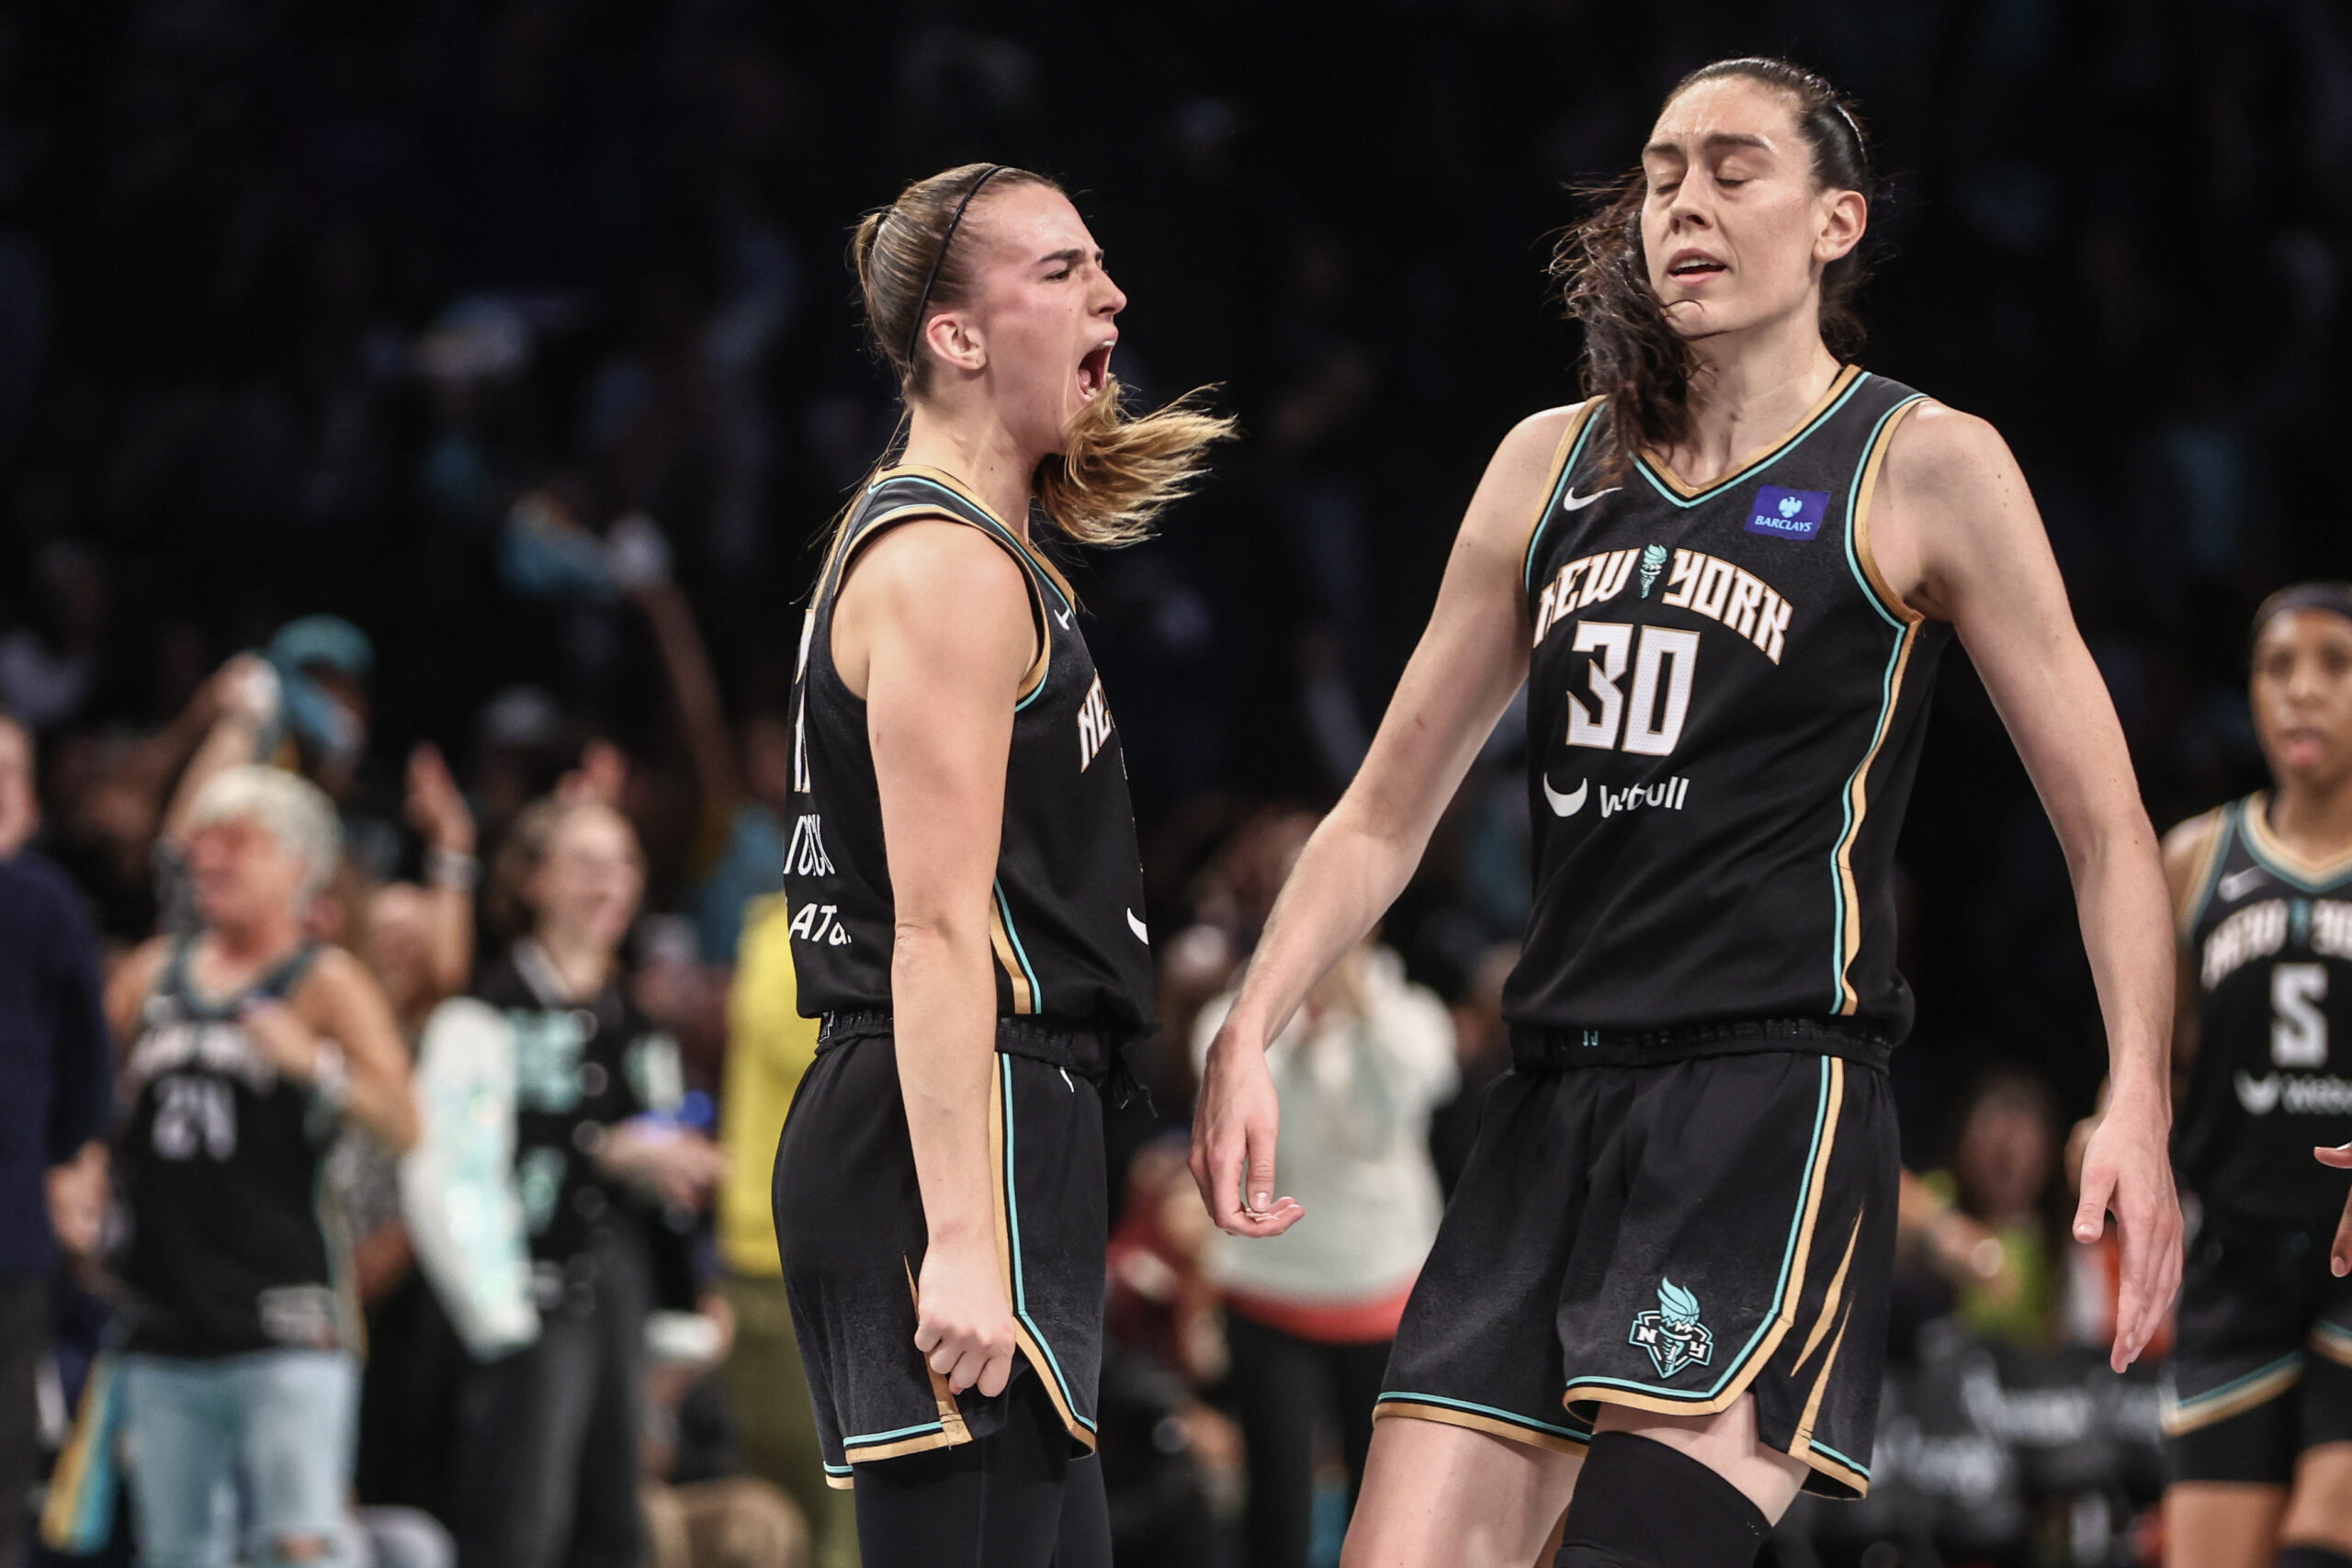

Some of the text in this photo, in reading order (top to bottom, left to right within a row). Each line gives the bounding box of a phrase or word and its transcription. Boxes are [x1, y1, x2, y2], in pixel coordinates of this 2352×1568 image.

[1754, 515, 1813, 532] BARCLAYS
[1533, 548, 1793, 666] NEW YORK
[1078, 671, 1115, 773] NE
[1566, 620, 1701, 757] 30
[2269, 962, 2329, 1068] 5
